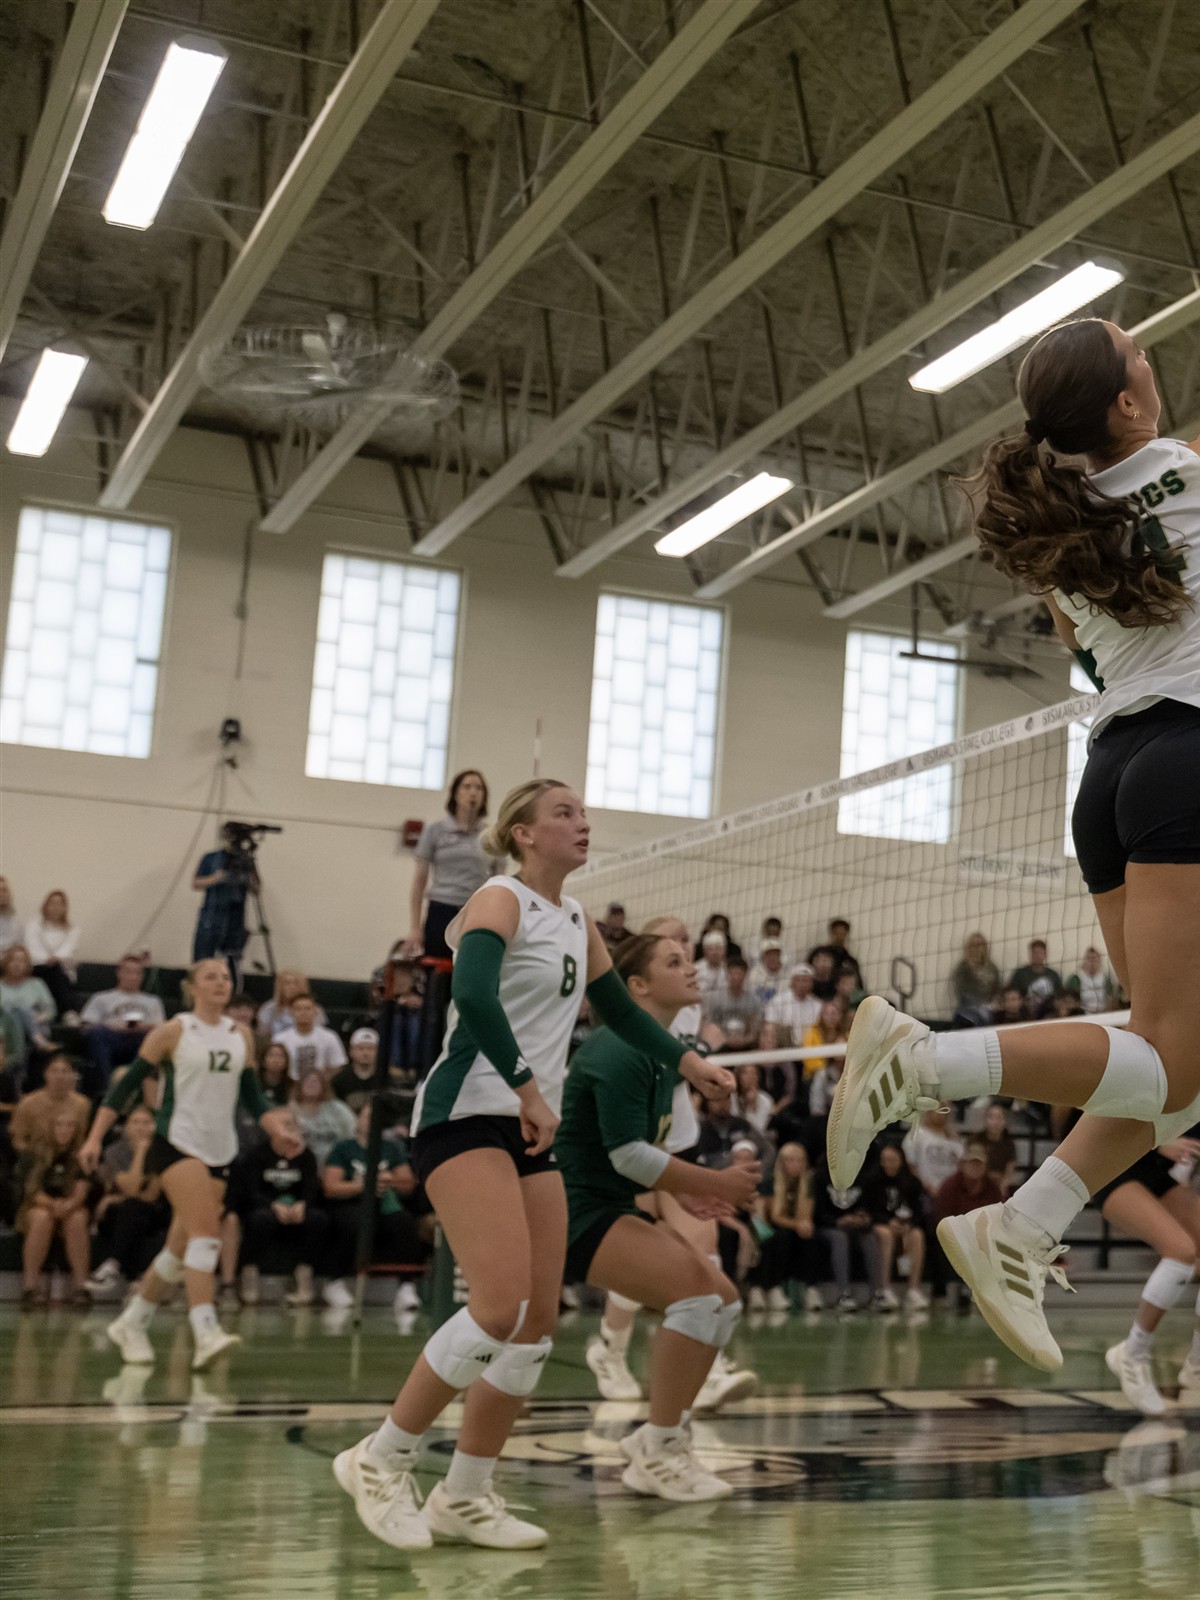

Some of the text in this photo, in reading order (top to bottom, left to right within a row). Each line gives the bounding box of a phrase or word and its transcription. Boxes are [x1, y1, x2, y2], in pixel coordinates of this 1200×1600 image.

[1042, 699, 1085, 726] BISMARCK
[560, 953, 577, 998] 8
[208, 1050, 232, 1073] 12
